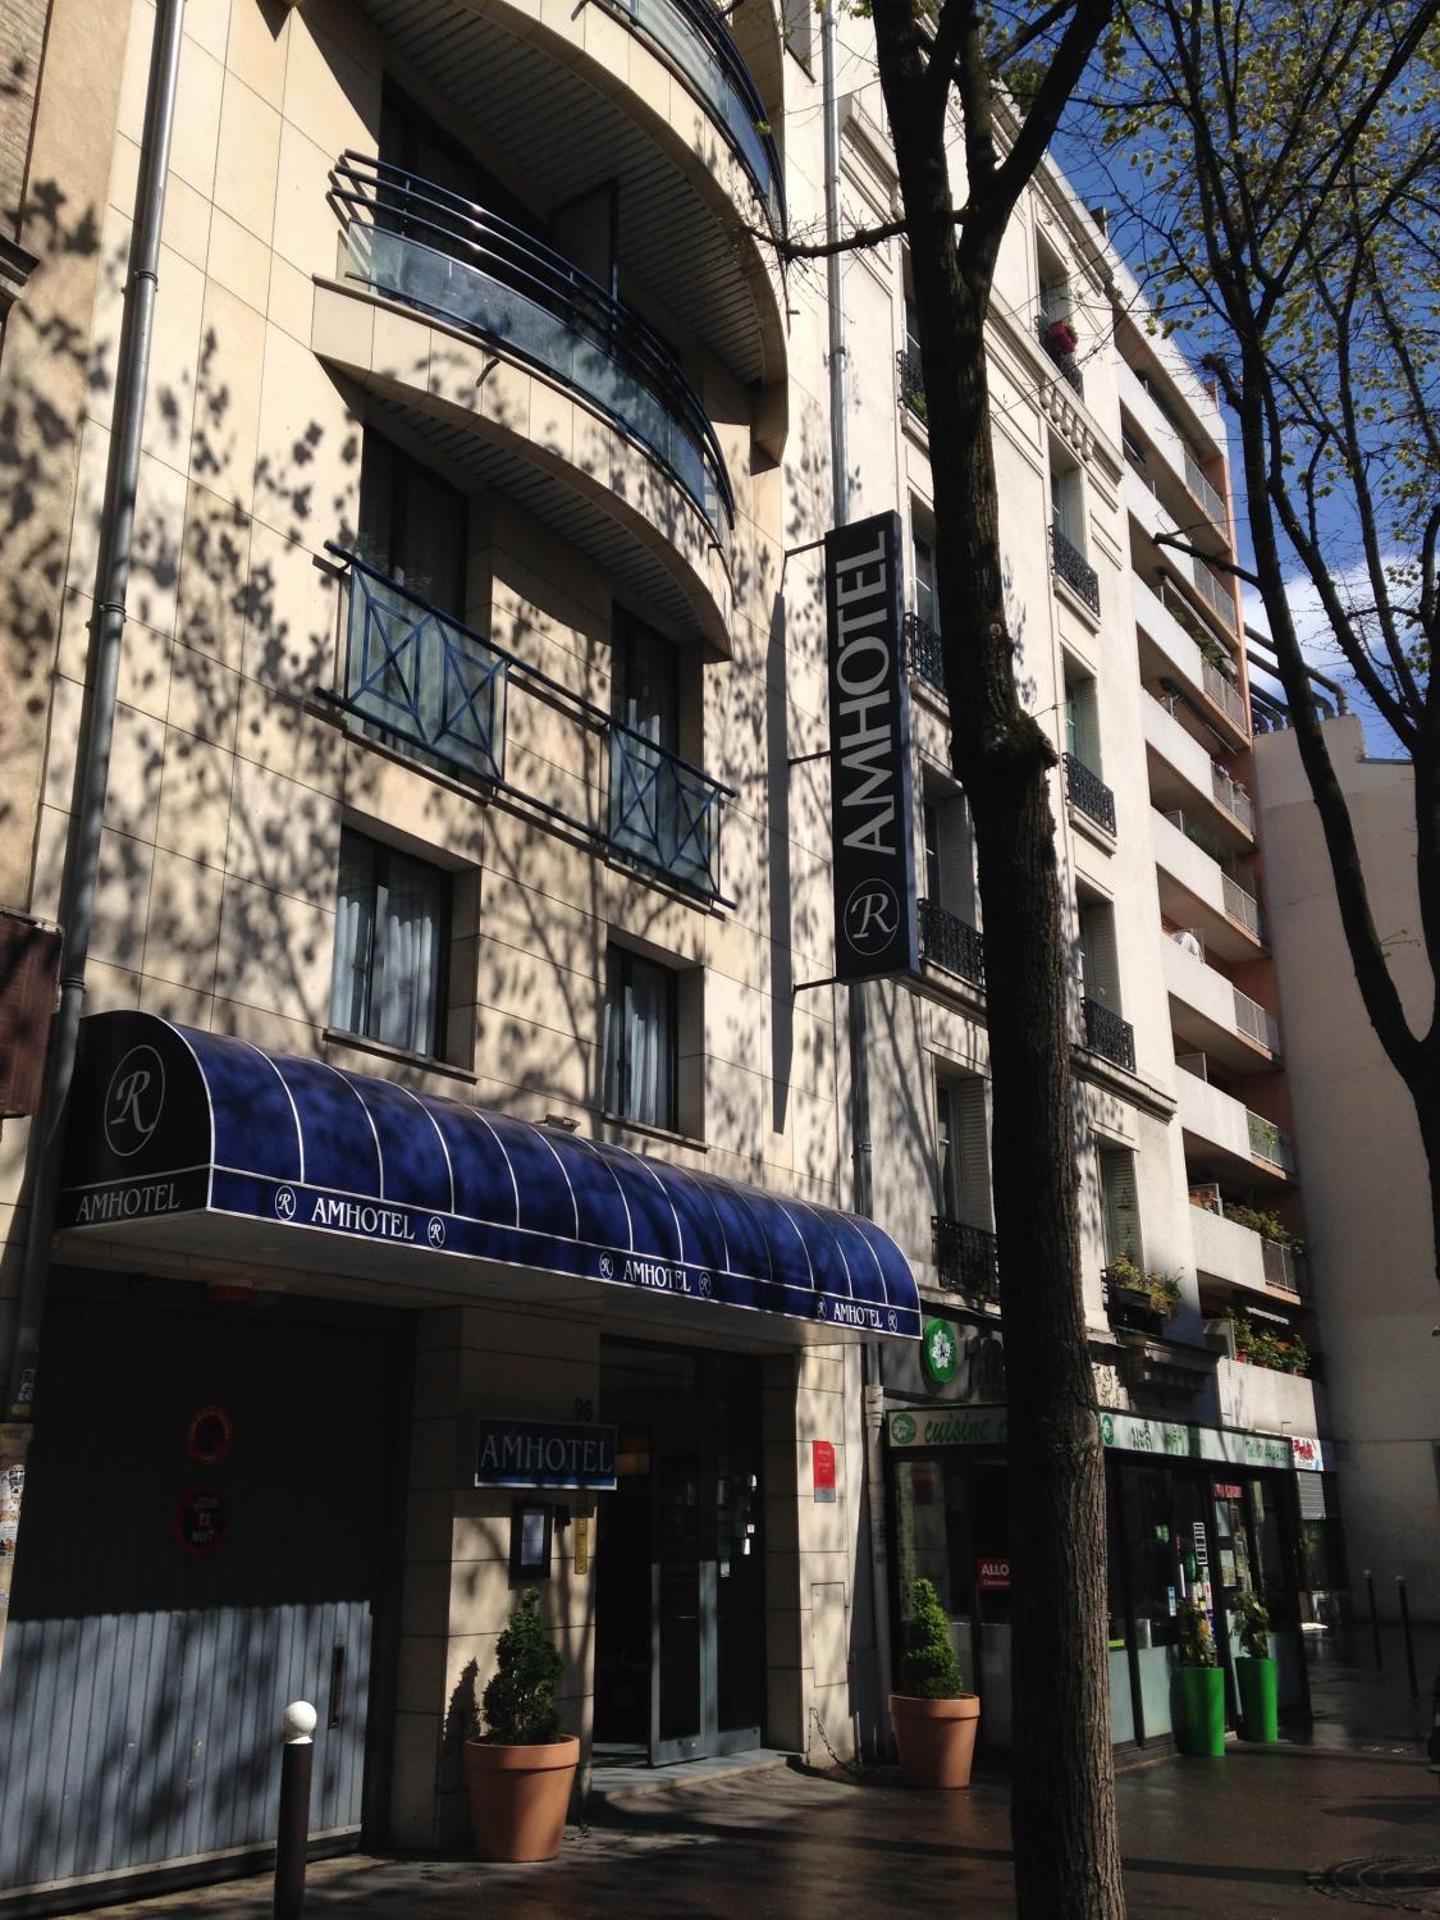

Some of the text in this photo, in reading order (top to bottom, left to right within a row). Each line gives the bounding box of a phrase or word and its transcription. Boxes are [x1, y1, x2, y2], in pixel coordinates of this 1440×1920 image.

[836, 530, 897, 856] AMHOTEL
[75, 1182, 183, 1223] AMHOTEL
[310, 1196, 416, 1241] AMHOTEL
[622, 1258, 692, 1293] AMHOTEL
[832, 1301, 884, 1330] AMHOTEL
[480, 1434, 613, 1474] AMHOTEL
